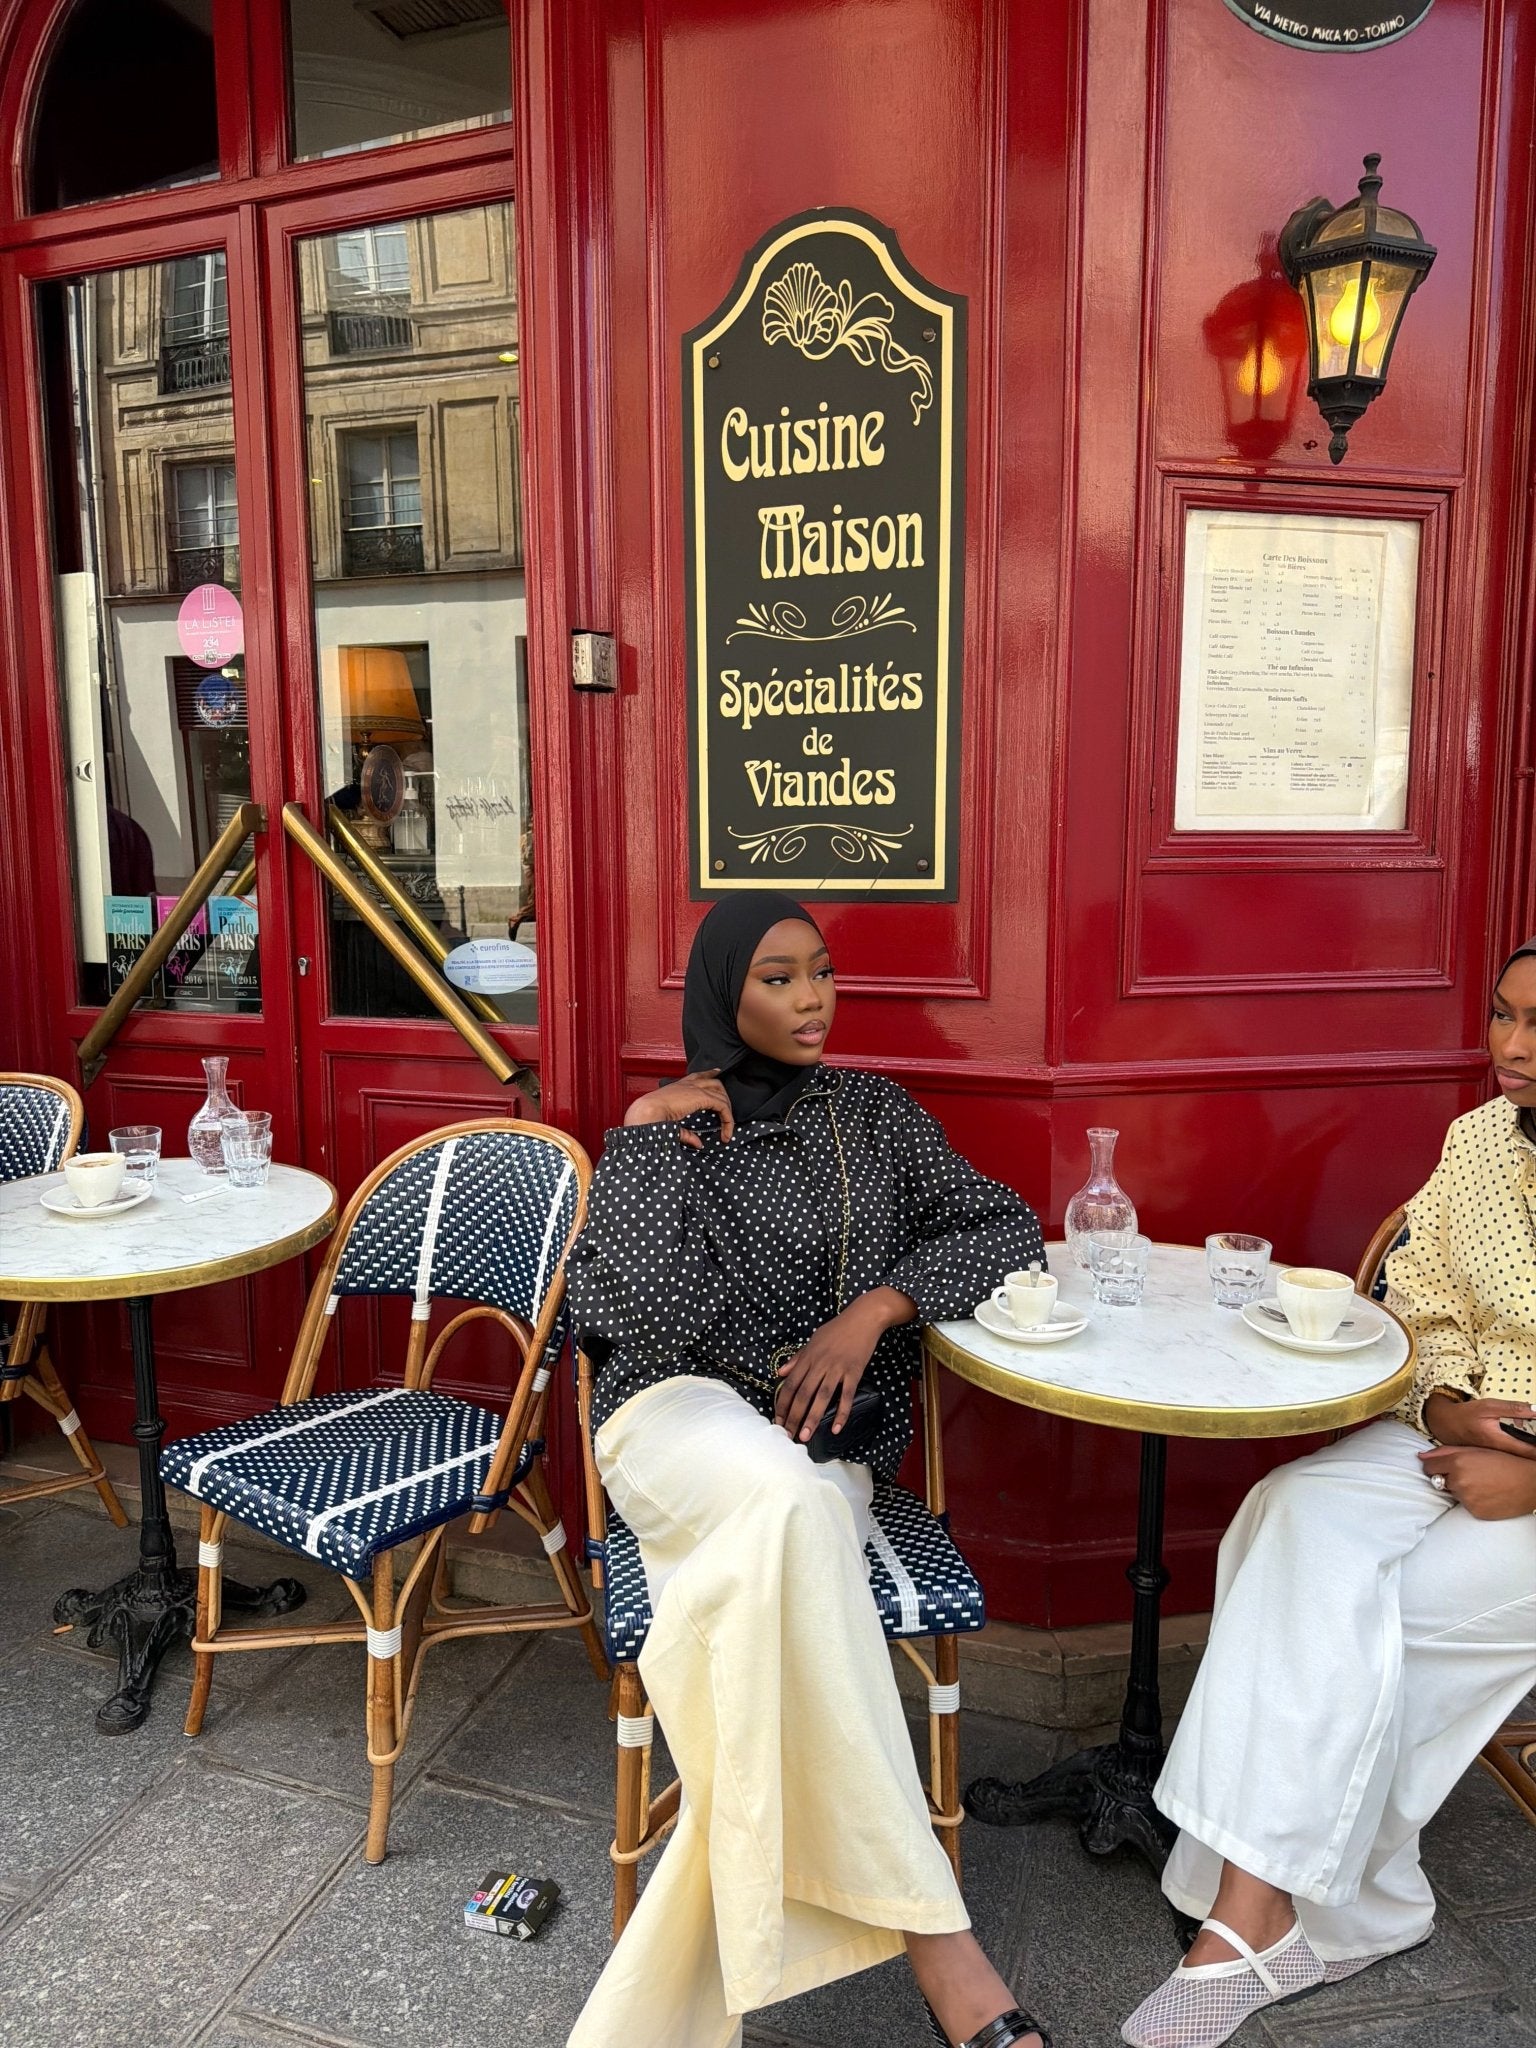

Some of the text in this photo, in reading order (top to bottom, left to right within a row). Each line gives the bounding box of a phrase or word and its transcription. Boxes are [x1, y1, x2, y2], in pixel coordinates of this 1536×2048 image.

[1254, 2, 1271, 22] VIA
[1273, 14, 1309, 37] PIETRO
[1311, 27, 1342, 42] MICCA
[721, 401, 885, 482] Cuisine
[757, 503, 925, 580] Maison
[1263, 553, 1328, 564] Carte Des Boissons
[719, 661, 923, 730] Spécialités
[802, 726, 834, 756] de
[744, 757, 896, 807] Viandes
[218, 915, 254, 934] Pudlo
[113, 933, 146, 950] PARIS
[220, 933, 255, 951] PARIS
[479, 943, 510, 953] eurofins
[184, 976, 203, 985] 2016
[238, 976, 258, 985] 2015
